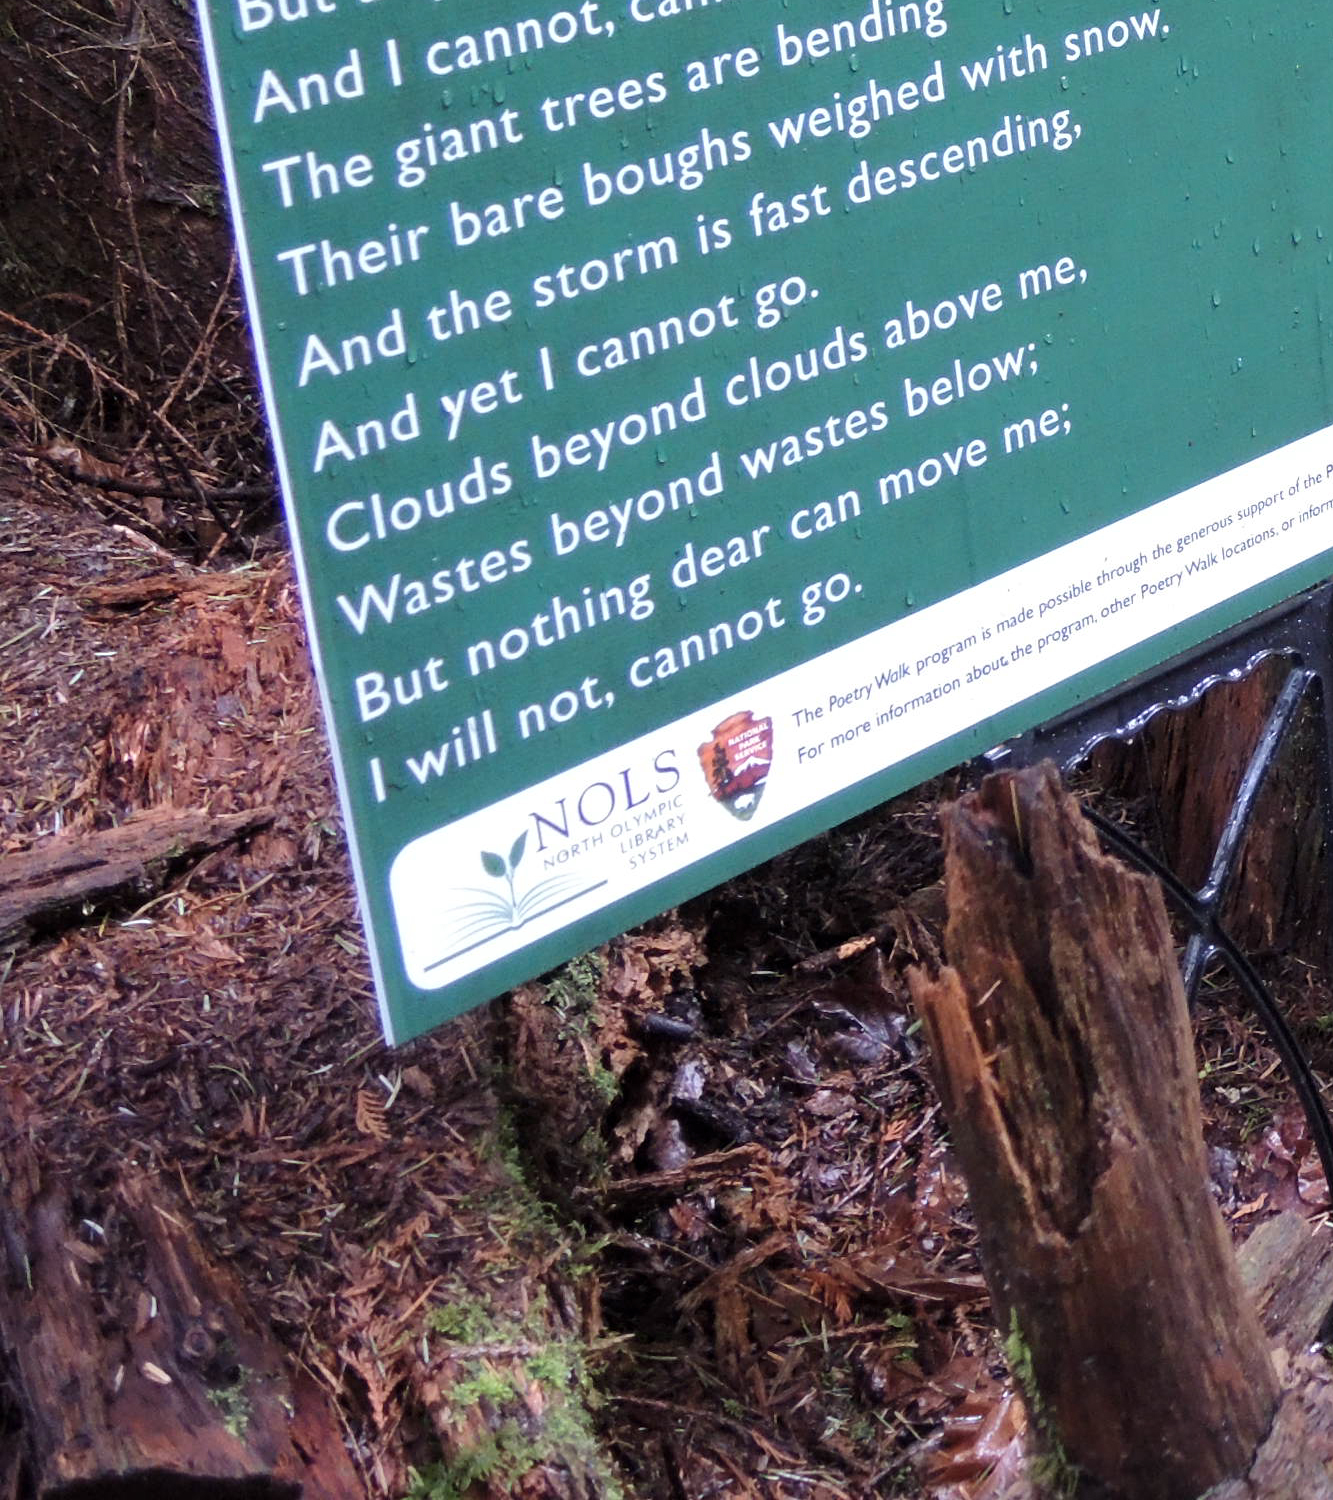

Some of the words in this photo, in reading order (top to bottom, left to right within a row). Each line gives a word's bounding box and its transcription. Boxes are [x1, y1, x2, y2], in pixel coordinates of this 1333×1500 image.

[254, 49, 364, 123] And
[387, 39, 402, 86] I
[427, 0, 614, 75] cannot,
[262, 152, 373, 207] The
[396, 109, 523, 188] giant
[541, 72, 667, 131] trees
[687, 48, 759, 92] are
[277, 224, 429, 295] Their
[450, 188, 564, 246] bare
[583, 128, 751, 206] boughs
[768, 60, 945, 148] weighed
[960, 34, 1047, 91] with
[1065, 9, 1169, 61] snow.
[299, 308, 406, 387] And
[427, 290, 512, 340] the
[533, 237, 678, 307] storm
[697, 215, 731, 254] is
[749, 184, 831, 236] fast
[848, 110, 1081, 203] descending,
[314, 393, 420, 472] And
[441, 370, 522, 440] yet
[540, 347, 554, 390] I
[577, 296, 738, 376] cannot
[756, 276, 818, 328] go.
[327, 456, 512, 551] Clouds
[532, 377, 706, 478] beyond
[726, 326, 867, 405] clouds
[885, 284, 1002, 348] above
[1019, 257, 1087, 299] me,
[336, 540, 532, 634] Wastes
[551, 452, 723, 555] beyond
[740, 402, 888, 479] wastes
[904, 343, 1037, 417] below;
[356, 658, 448, 722] But
[468, 574, 654, 676] nothing
[672, 526, 770, 588] dear
[791, 491, 860, 539] can
[879, 440, 987, 504] move
[1004, 404, 1071, 453] me;
[790, 706, 824, 727] The
[828, 683, 873, 712] Poetry
[873, 662, 911, 689] Walk
[915, 635, 977, 676] program
[980, 627, 992, 640] is
[995, 606, 1034, 633] made
[1037, 579, 1093, 618] possible
[1095, 551, 1148, 586] through
[1150, 543, 1173, 559] the
[1175, 514, 1234, 553] generous
[1236, 490, 1285, 520] support
[1287, 476, 1300, 496] of
[1302, 473, 1323, 489] the
[796, 742, 825, 764] For
[829, 721, 871, 748] more
[875, 678, 961, 726] information
[964, 655, 1010, 683] about
[1009, 643, 1033, 661] the
[1099, 593, 1137, 618] other
[1139, 571, 1183, 599] Poetry
[1183, 552, 1219, 575] Walk
[1280, 517, 1295, 531] or
[370, 758, 386, 802] I
[406, 710, 496, 784] will
[519, 677, 614, 738] not,
[630, 598, 785, 687] cannot
[802, 573, 862, 626] go.
[529, 749, 681, 852] NOLS
[543, 834, 604, 871] NORTH
[610, 794, 683, 839] OLYMPIC
[620, 813, 686, 855] LIBRARY
[629, 832, 690, 871] SYSTEM
